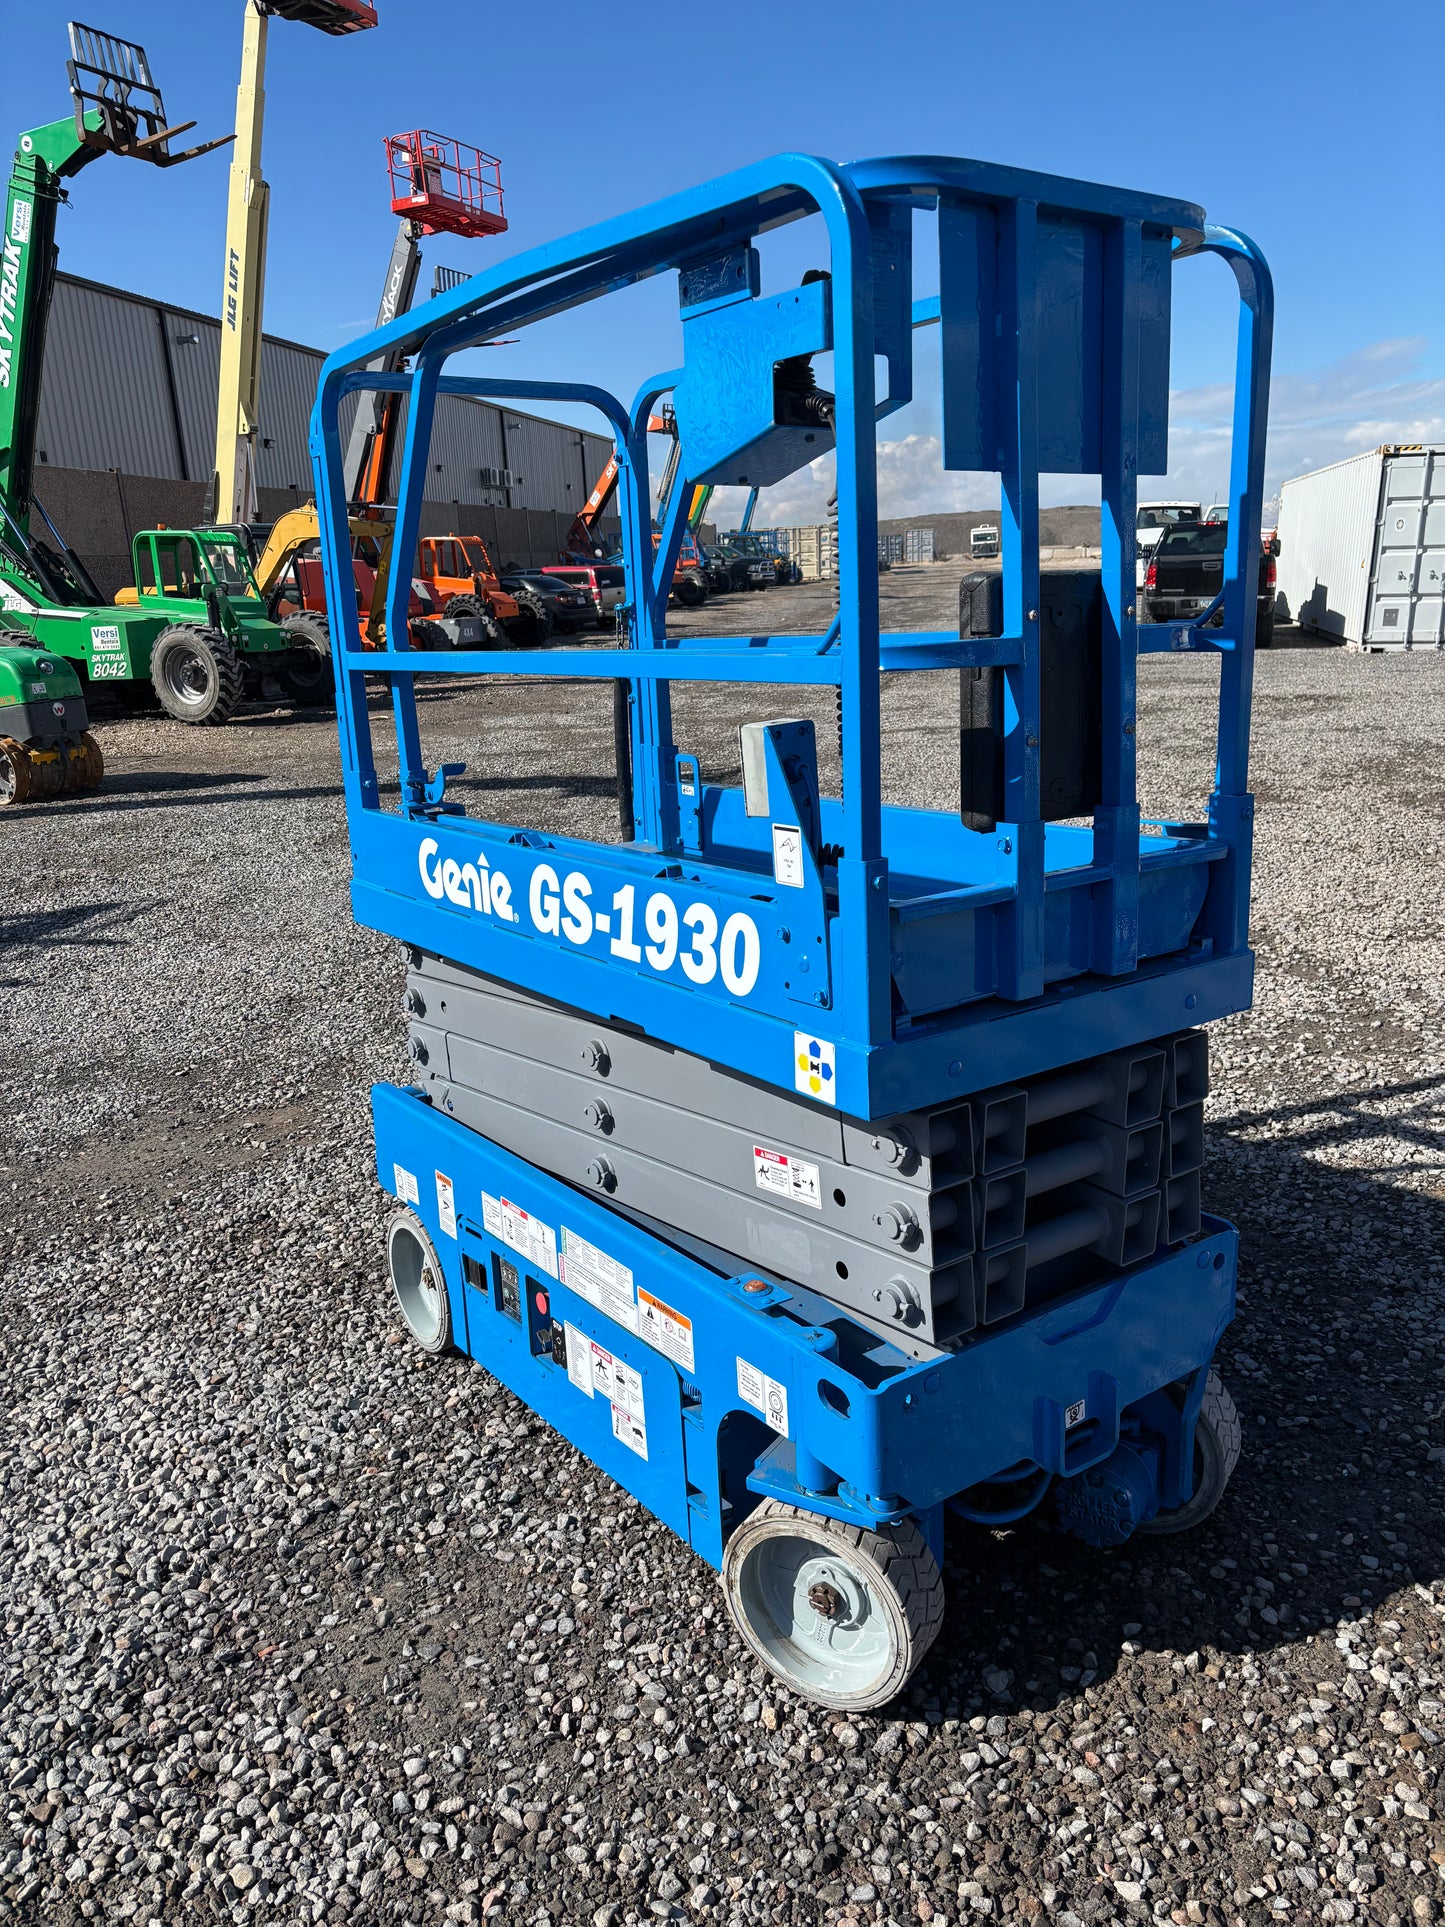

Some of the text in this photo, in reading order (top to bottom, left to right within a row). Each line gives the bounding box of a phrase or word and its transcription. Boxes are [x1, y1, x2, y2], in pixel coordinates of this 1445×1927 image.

[227, 248, 240, 332] JLG LIFT
[382, 264, 404, 327] YJACK
[92, 627, 118, 639] Versi
[91, 653, 125, 663] SKYTRAK
[93, 662, 127, 678] 8042
[529, 863, 761, 997] GS-1930
